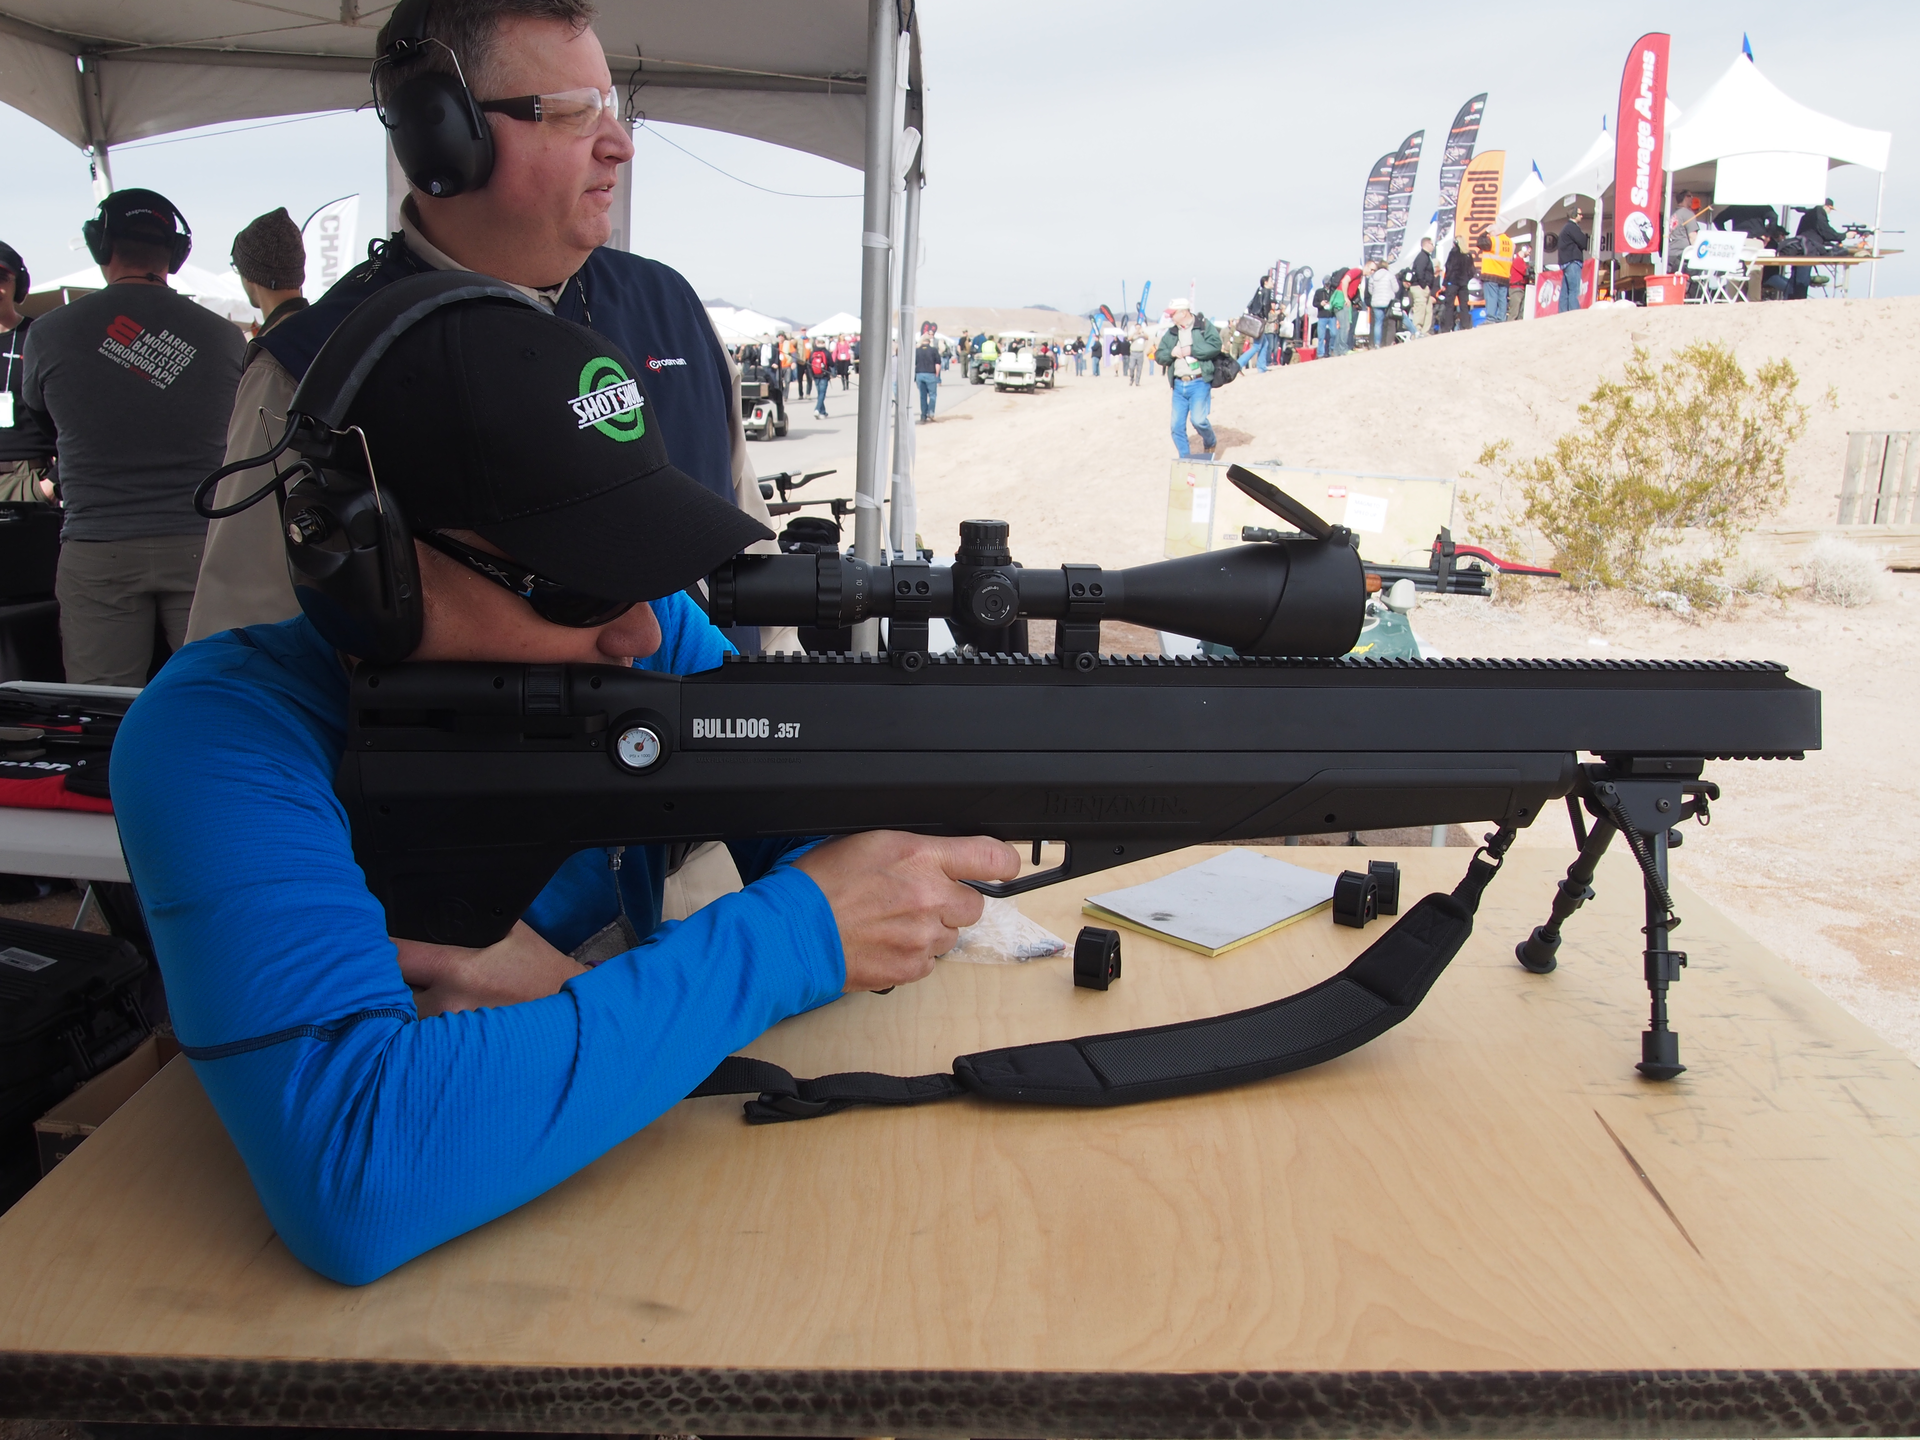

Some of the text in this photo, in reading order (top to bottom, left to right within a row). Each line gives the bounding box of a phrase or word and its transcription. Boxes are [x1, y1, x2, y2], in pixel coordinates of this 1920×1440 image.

[1631, 49, 1656, 208] Savage Arms
[1463, 170, 1500, 259] shnell
[102, 337, 176, 385] CHRONOGRAPH
[131, 340, 183, 376] BALLISTIC
[142, 333, 191, 367] MOUNTED
[158, 329, 197, 359] BARREL
[855, 578, 863, 586] 10
[855, 592, 863, 600] 12
[692, 718, 801, 739] BULLDOG .357
